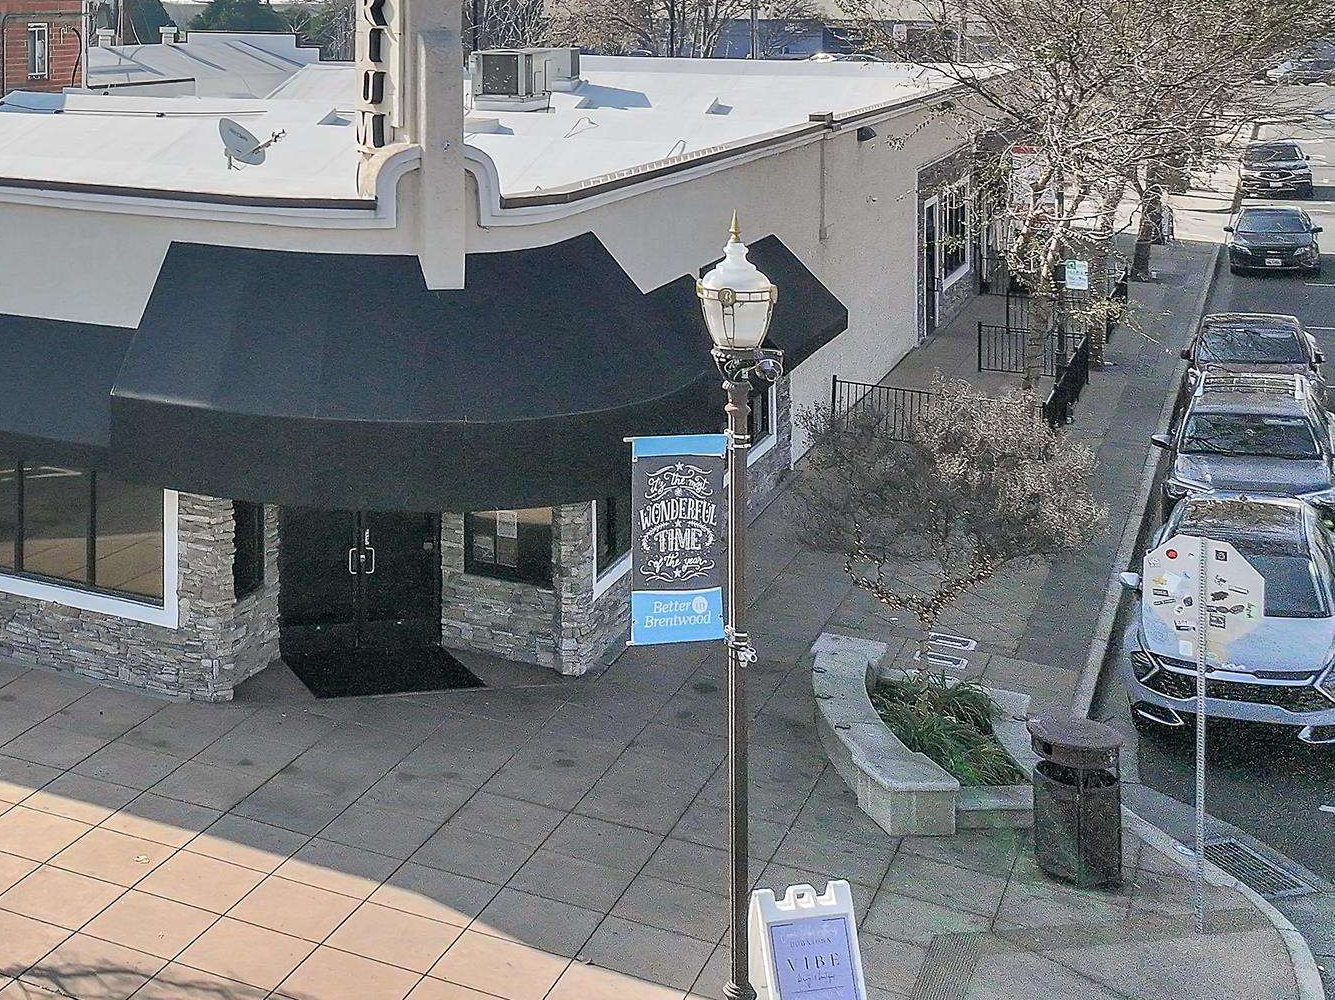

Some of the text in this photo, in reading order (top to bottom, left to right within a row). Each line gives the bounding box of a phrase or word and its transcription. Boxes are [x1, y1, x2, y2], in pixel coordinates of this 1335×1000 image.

[639, 497, 717, 531] WONDERFUL
[653, 527, 703, 553] TIME
[664, 552, 682, 569] the
[681, 555, 708, 573] year
[652, 600, 692, 615] Better
[644, 610, 712, 629] Brentwood
[786, 952, 841, 972] VIBE
